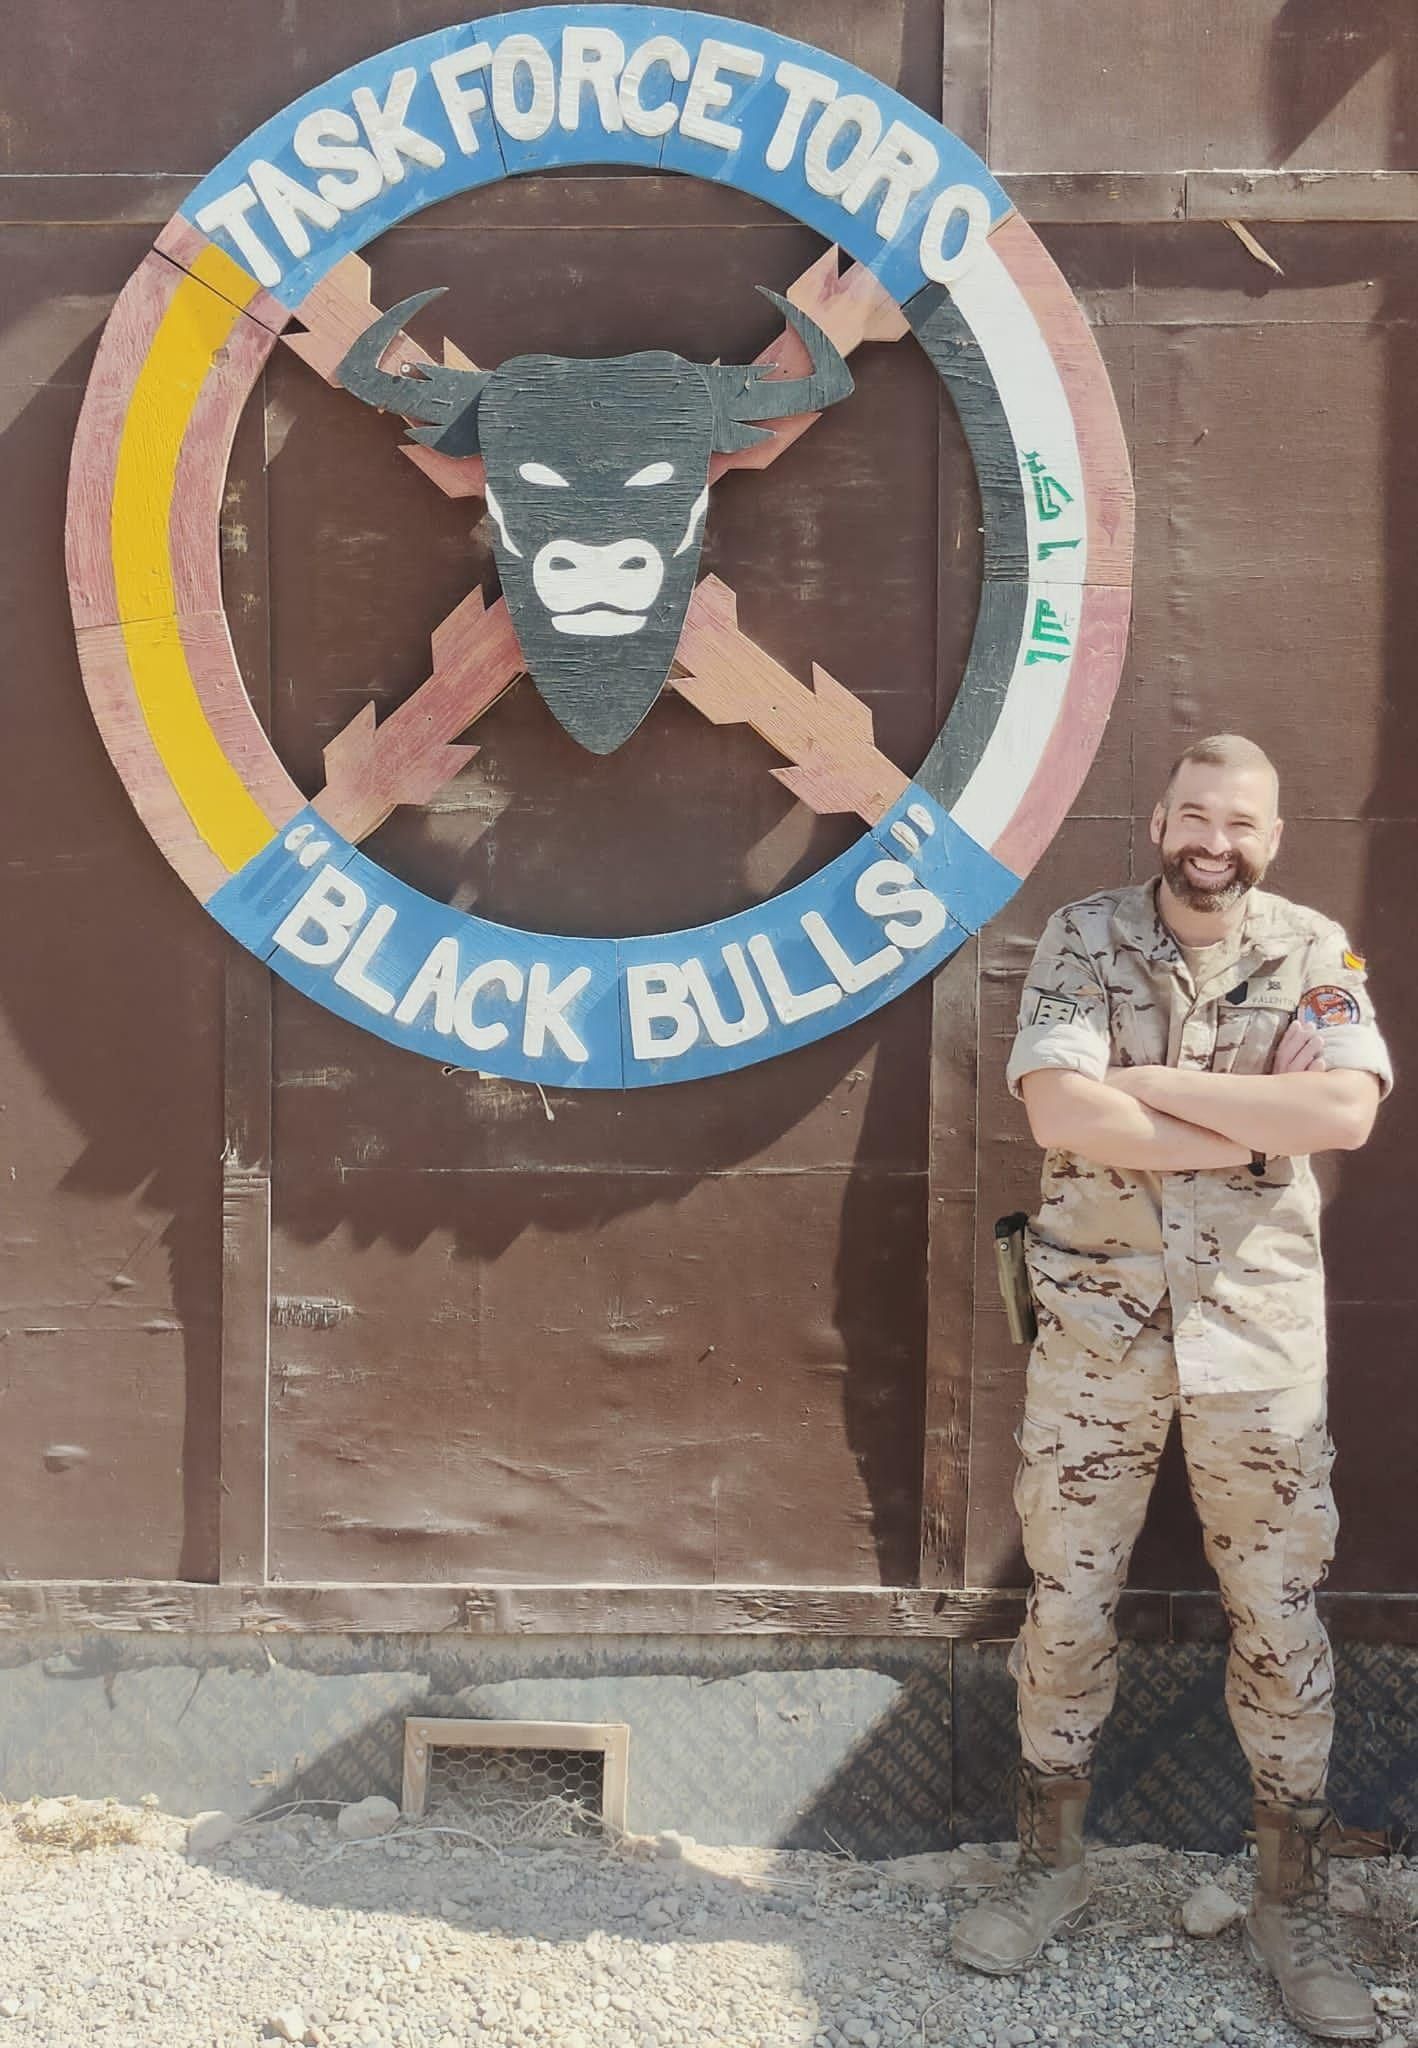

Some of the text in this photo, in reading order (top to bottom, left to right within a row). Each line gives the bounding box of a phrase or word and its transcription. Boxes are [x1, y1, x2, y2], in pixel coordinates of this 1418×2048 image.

[196, 26, 990, 288] TASK FORCE TORO
